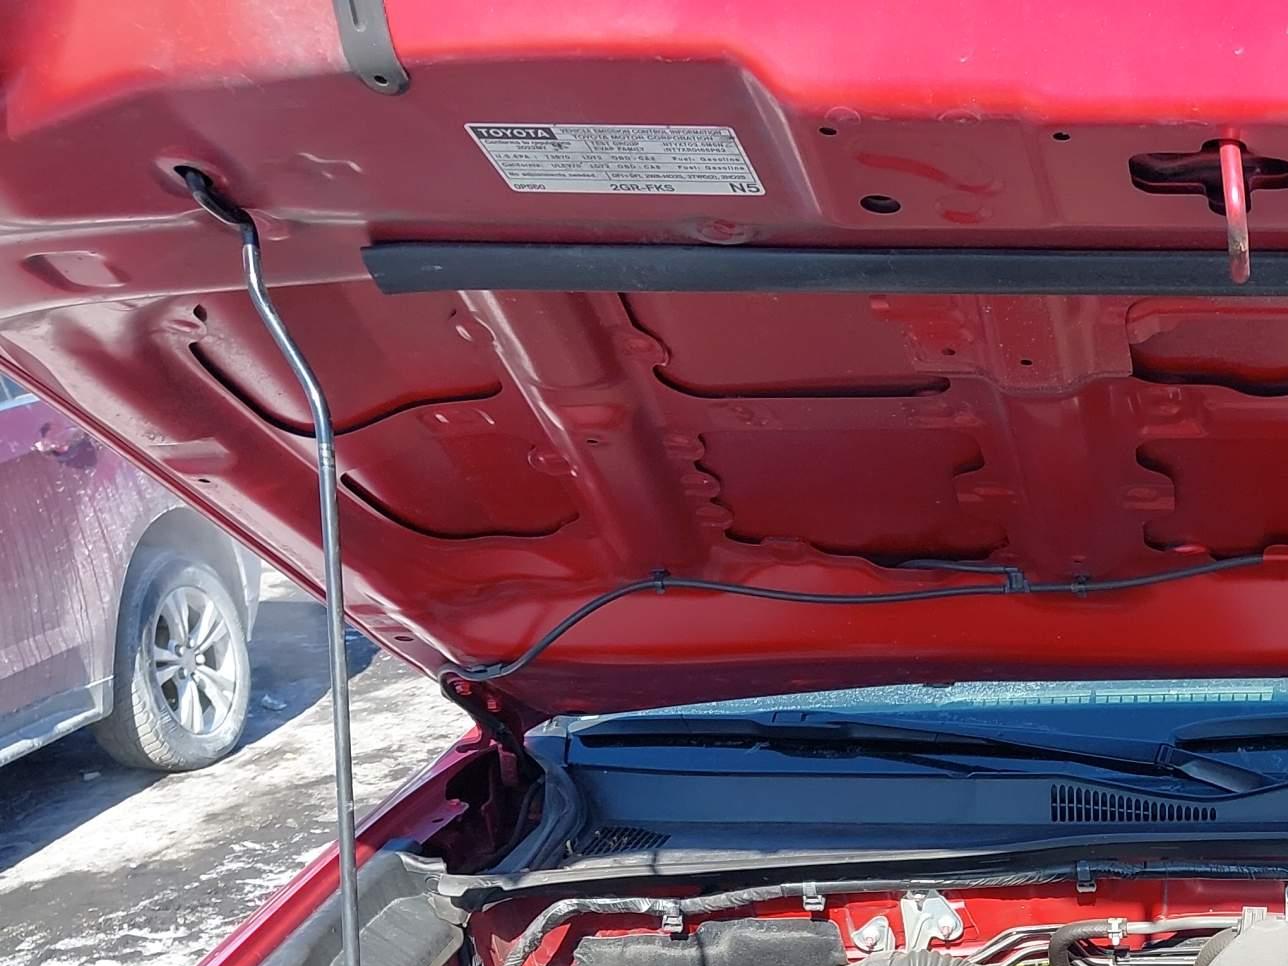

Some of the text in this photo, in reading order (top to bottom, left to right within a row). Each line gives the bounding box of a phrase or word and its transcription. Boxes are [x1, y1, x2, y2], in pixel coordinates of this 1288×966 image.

[477, 128, 550, 138] TOYOTA
[610, 183, 676, 192] 2GR-FKS
[729, 183, 761, 193] N5
